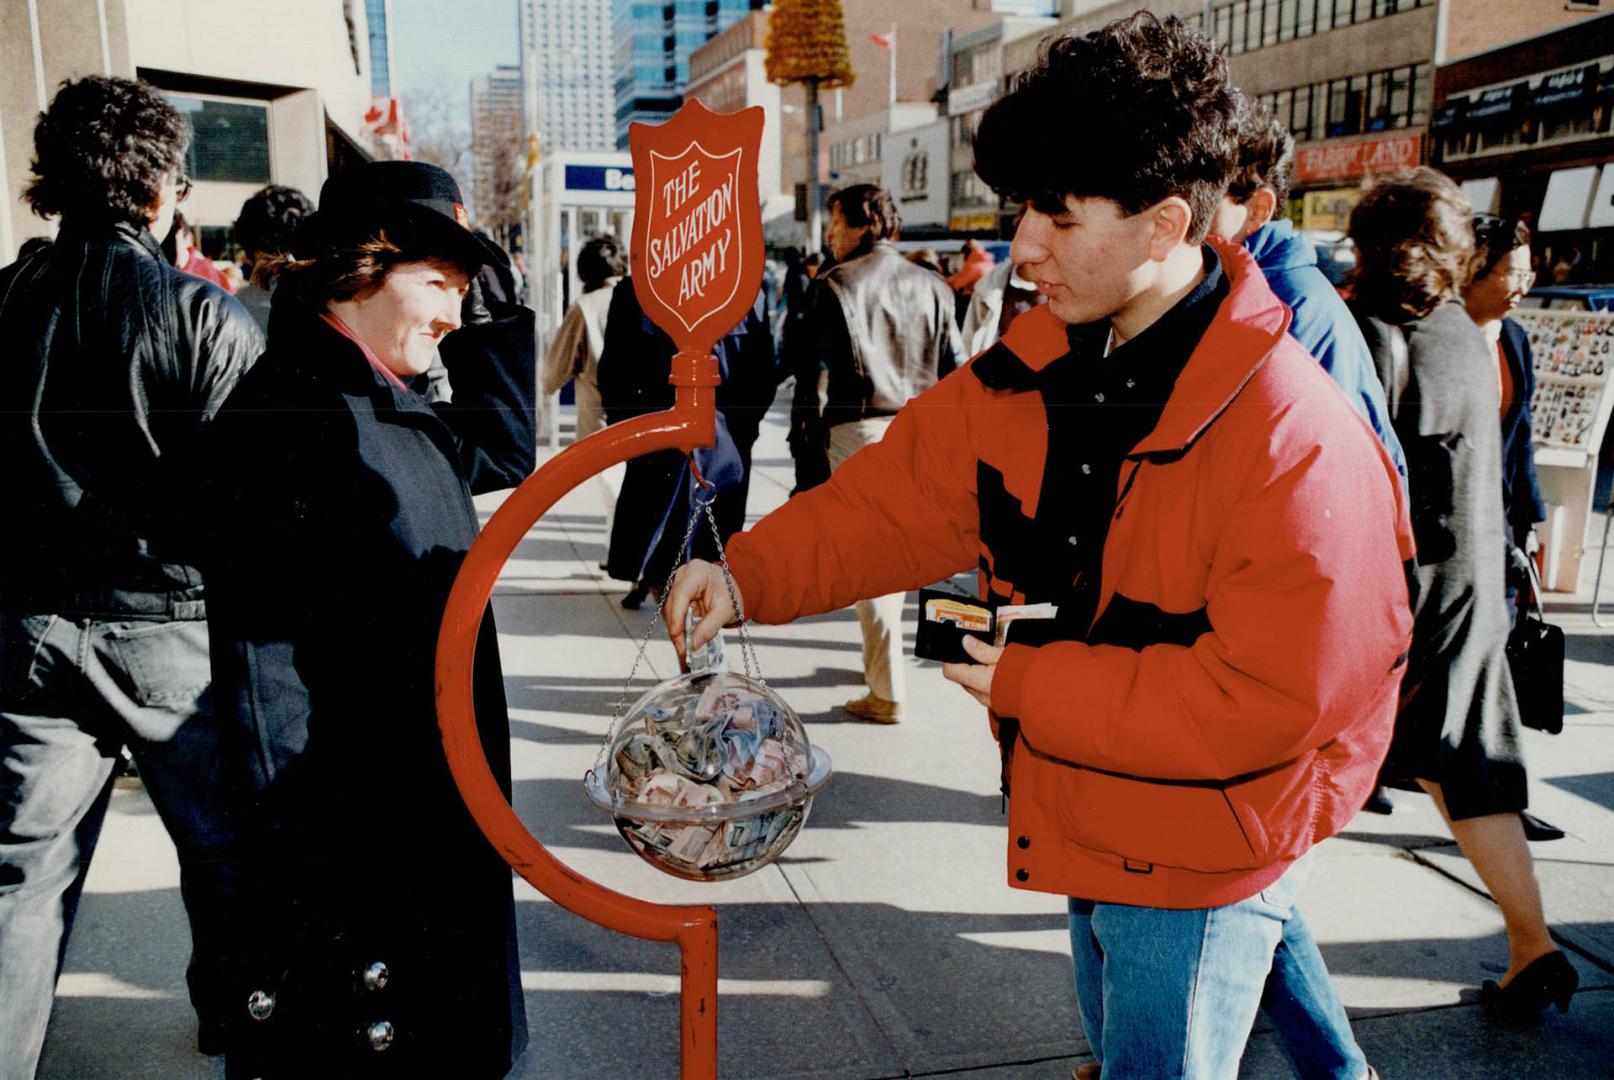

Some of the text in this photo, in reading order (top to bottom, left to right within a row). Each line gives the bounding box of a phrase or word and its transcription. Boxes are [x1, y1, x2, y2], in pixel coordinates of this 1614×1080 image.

[650, 173, 733, 278] SALVATION
[663, 160, 701, 218] THE
[677, 228, 731, 307] ARMY
